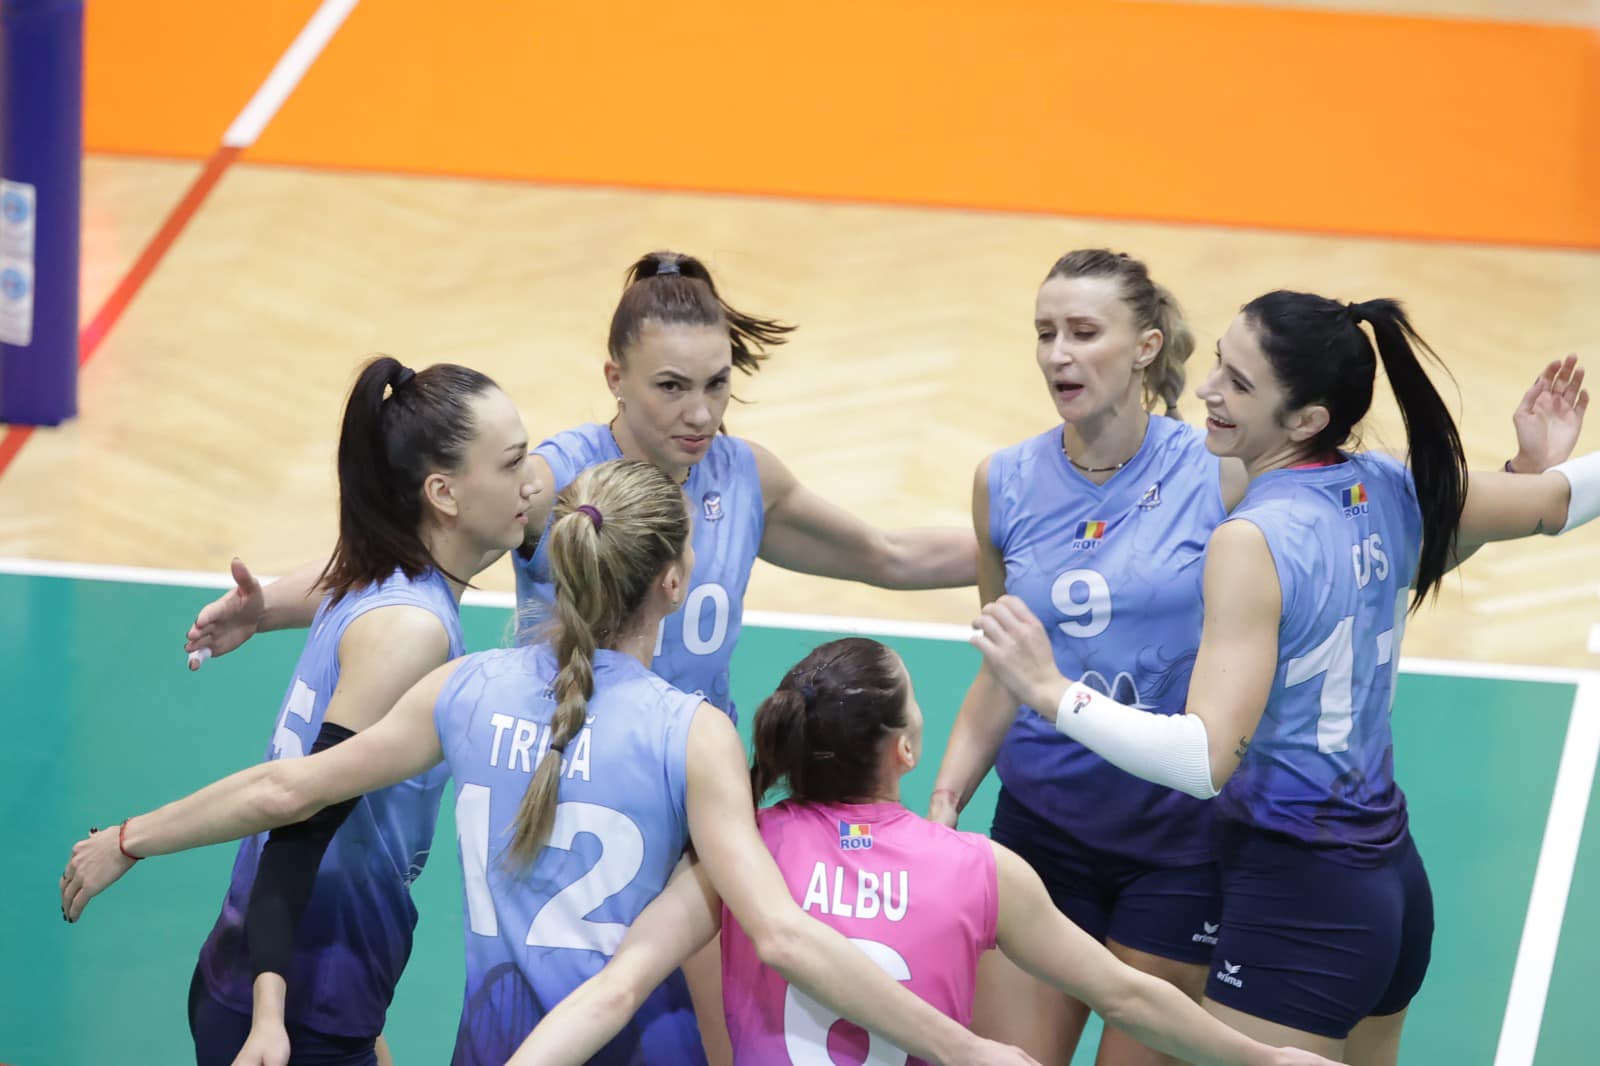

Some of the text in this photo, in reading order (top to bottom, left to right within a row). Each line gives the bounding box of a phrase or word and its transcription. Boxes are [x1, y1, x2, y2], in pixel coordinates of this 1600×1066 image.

[1344, 504, 1369, 520] ROU
[1051, 568, 1112, 638] 9
[489, 712, 596, 782] TRIĂ
[455, 783, 645, 956] 12
[840, 837, 872, 850] ROU
[802, 861, 909, 921] ALBU
[1216, 970, 1243, 988] erima
